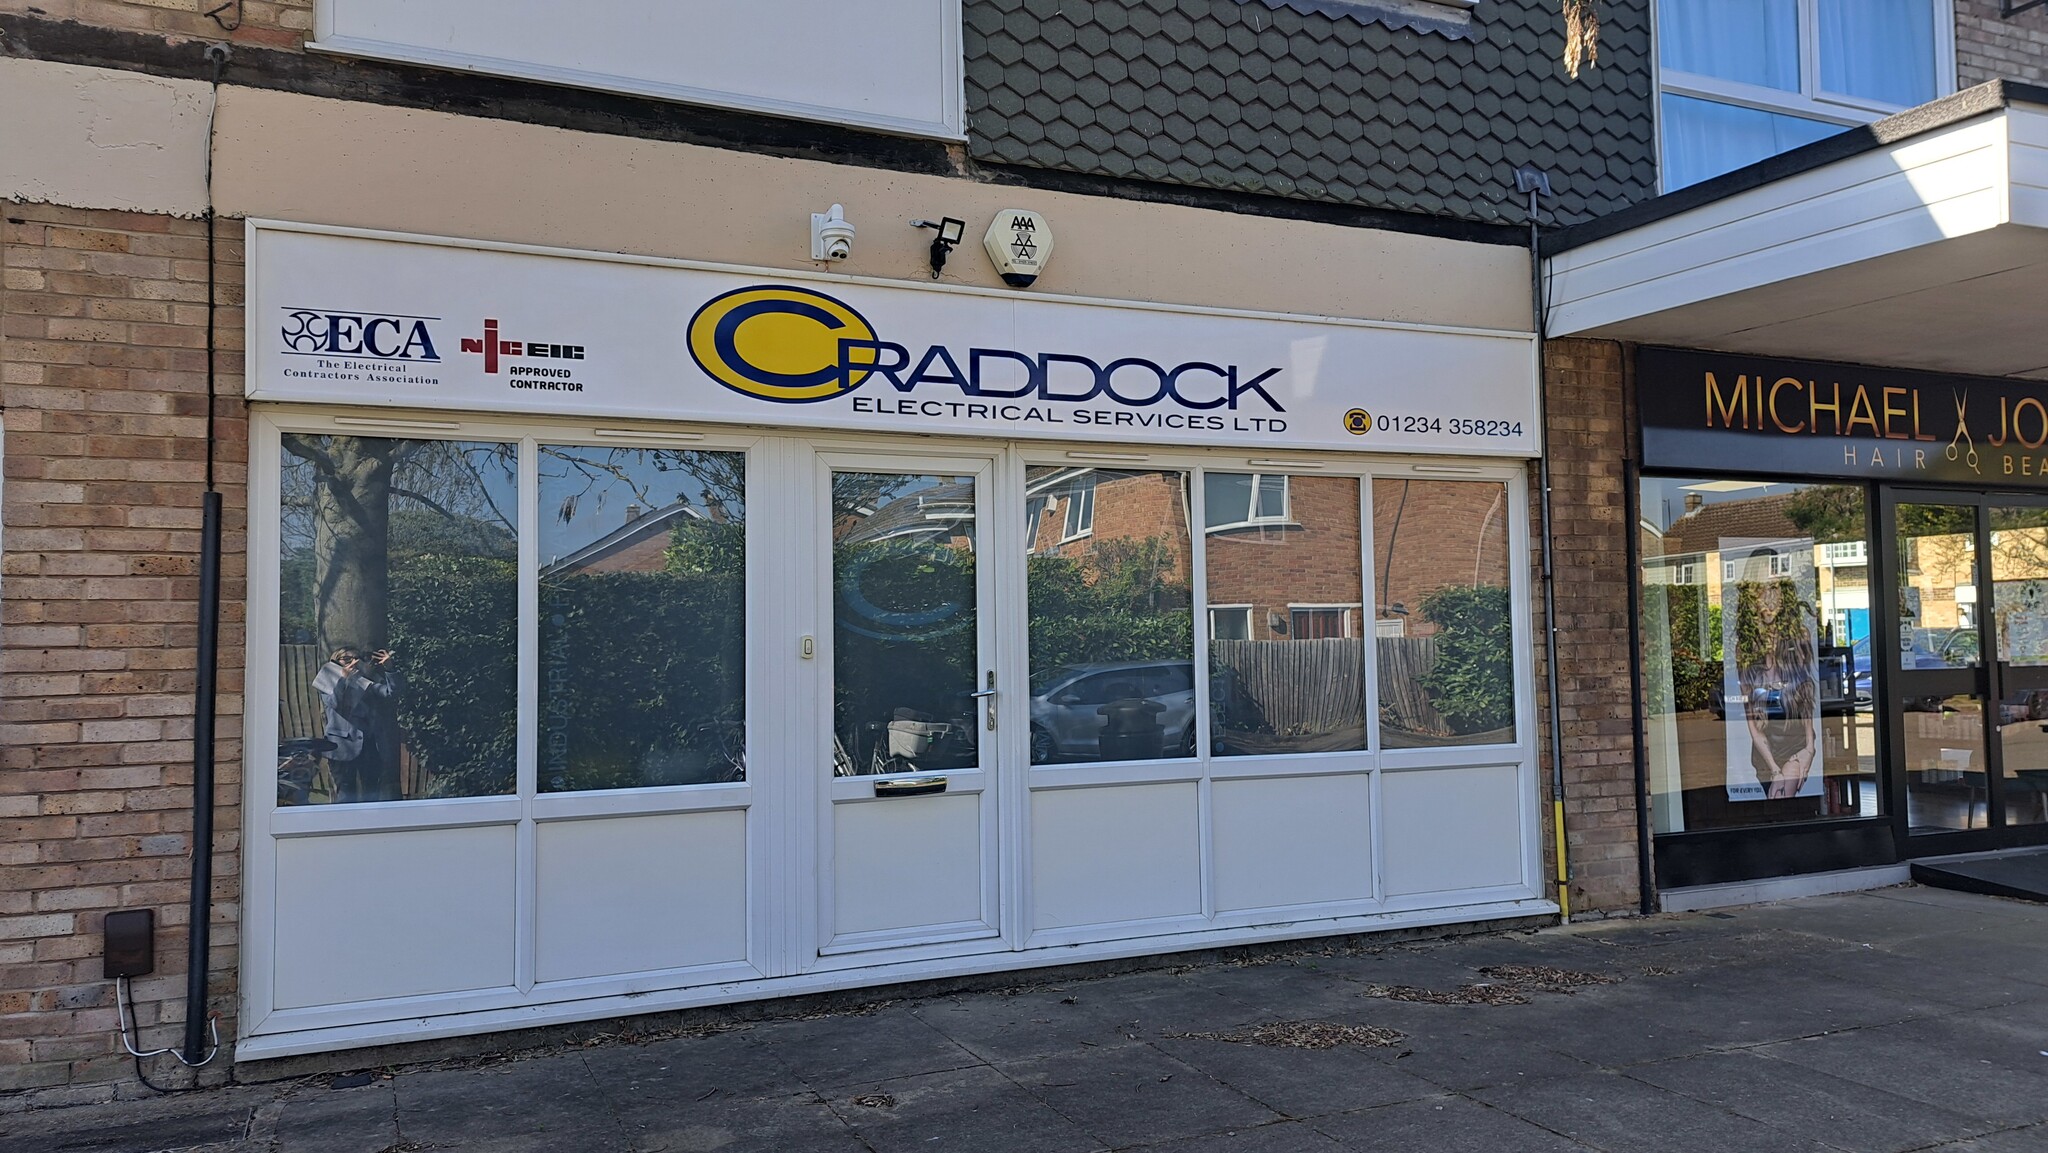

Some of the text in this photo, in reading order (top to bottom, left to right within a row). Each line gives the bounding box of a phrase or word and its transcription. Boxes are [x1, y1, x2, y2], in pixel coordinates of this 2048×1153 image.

[1011, 216, 1035, 231] AAA
[324, 314, 441, 360] ECA
[317, 360, 407, 373] The Electrical
[713, 298, 1286, 413] CRADDOCK
[283, 369, 439, 385] Contractors Association
[510, 366, 571, 378] APPROVED
[510, 379, 583, 392] CONTRACTOR
[852, 397, 1288, 433] ELECTRICAL SERVICES LTD
[1705, 372, 1936, 441] MICHAEL
[1377, 415, 1523, 437] 01234 358234
[1844, 445, 1926, 469] HAIR
